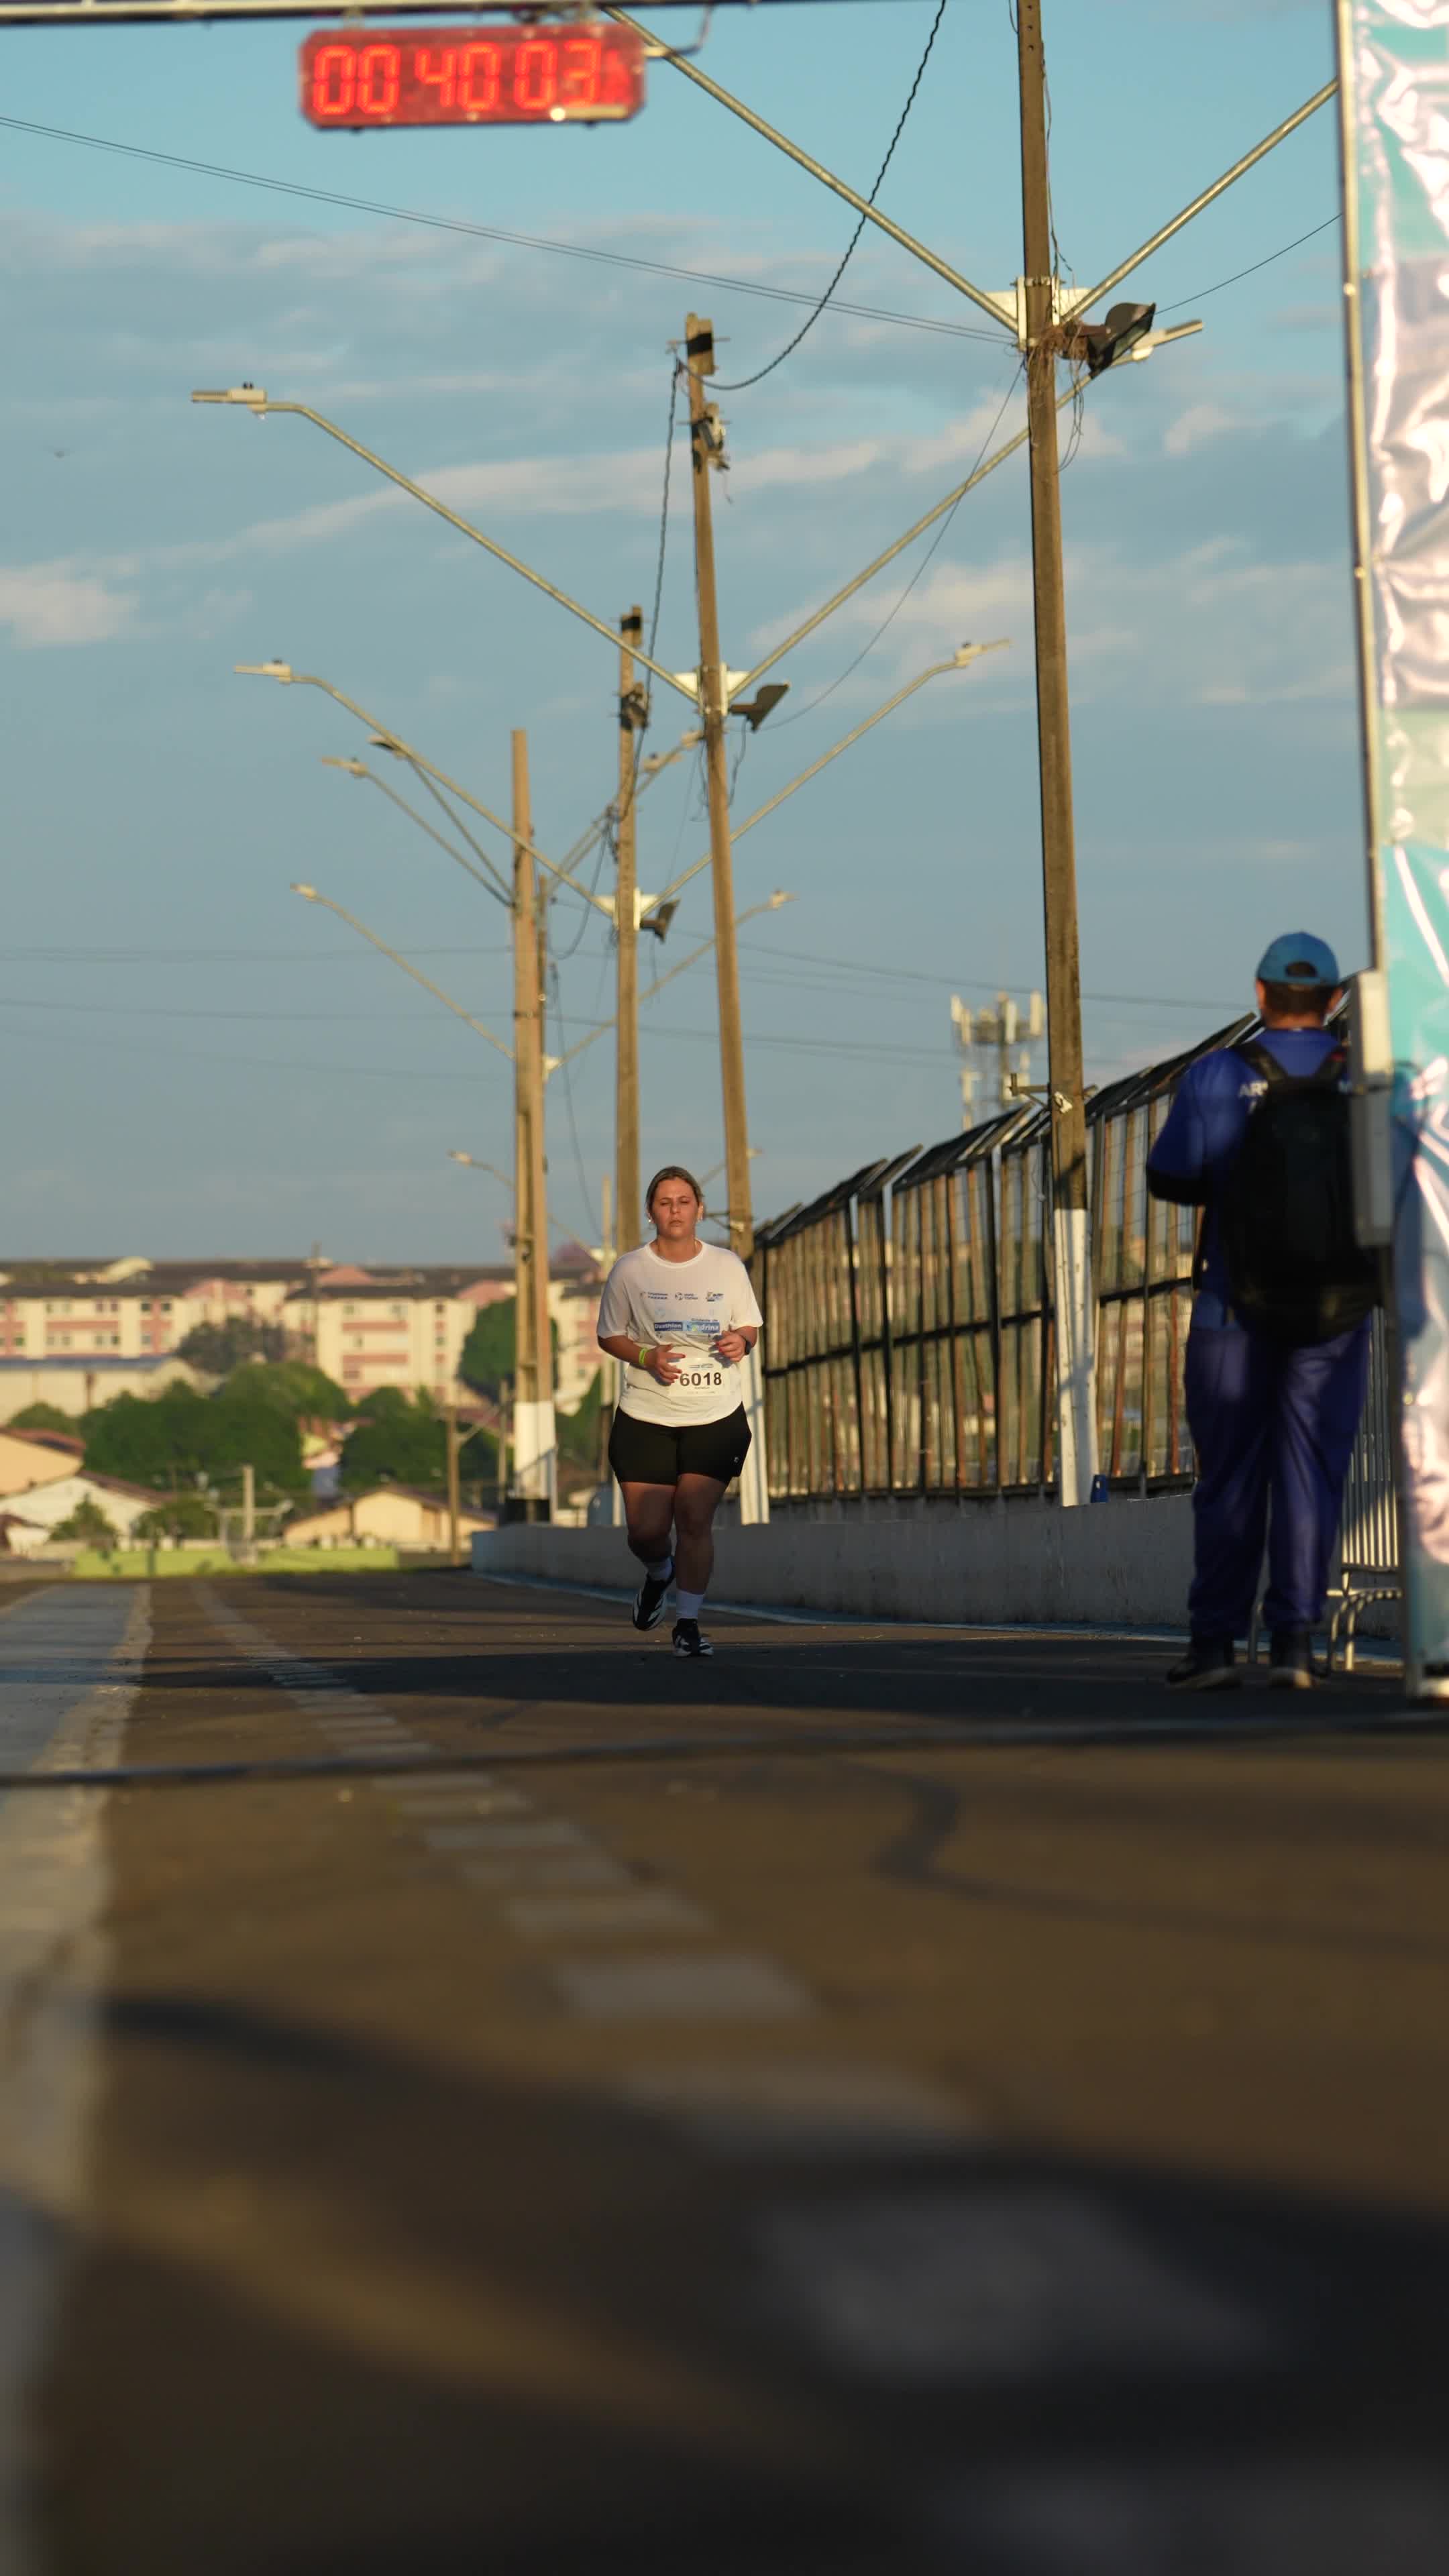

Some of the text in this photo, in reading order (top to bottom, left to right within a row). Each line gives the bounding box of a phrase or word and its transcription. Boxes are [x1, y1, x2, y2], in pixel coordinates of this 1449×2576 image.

[313, 40, 601, 115] 00 40 03
[680, 1372, 722, 1386] 6018
